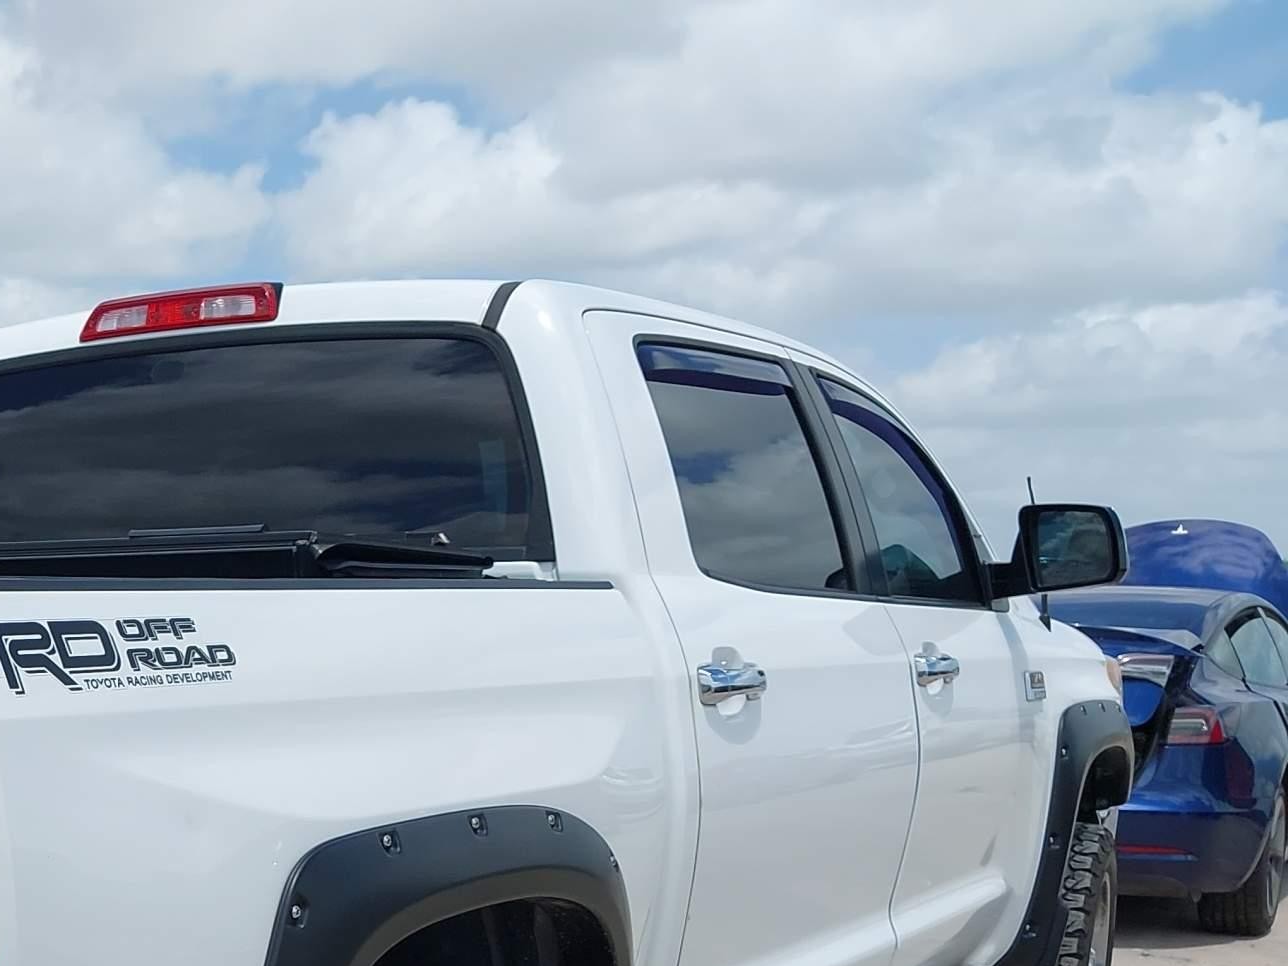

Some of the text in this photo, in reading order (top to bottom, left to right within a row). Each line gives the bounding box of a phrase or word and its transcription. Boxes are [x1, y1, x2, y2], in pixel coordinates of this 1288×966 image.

[115, 618, 197, 641] OFF
[126, 644, 236, 671] ROAD
[84, 670, 233, 690] TOYOTA RACING DEVELOPMENT
